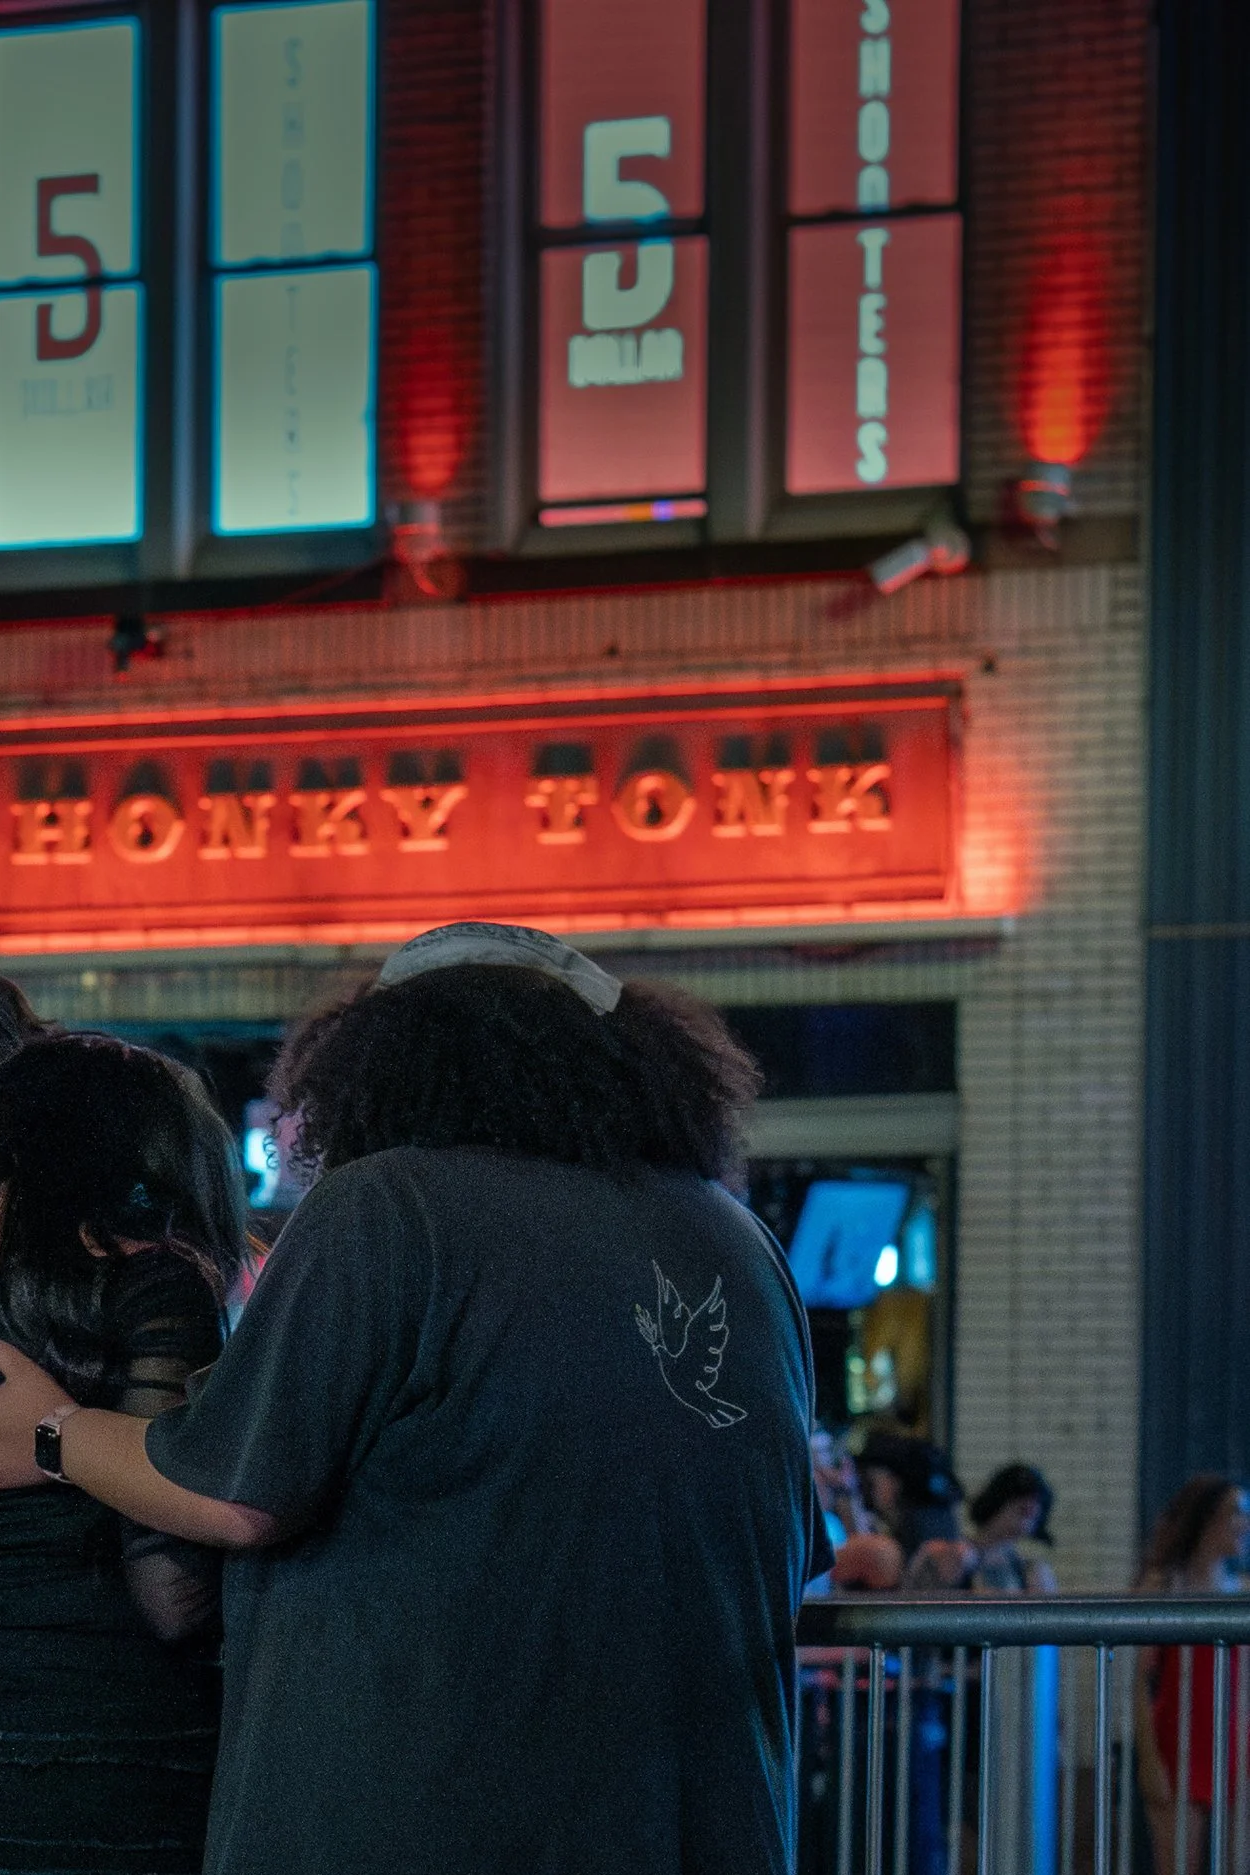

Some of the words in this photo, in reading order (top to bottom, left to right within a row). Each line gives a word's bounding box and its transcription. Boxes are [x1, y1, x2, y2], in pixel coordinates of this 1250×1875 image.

[36, 172, 102, 362] 5
[582, 115, 675, 331] 5
[10, 783, 468, 866] HONKY
[524, 763, 893, 845] TONK
